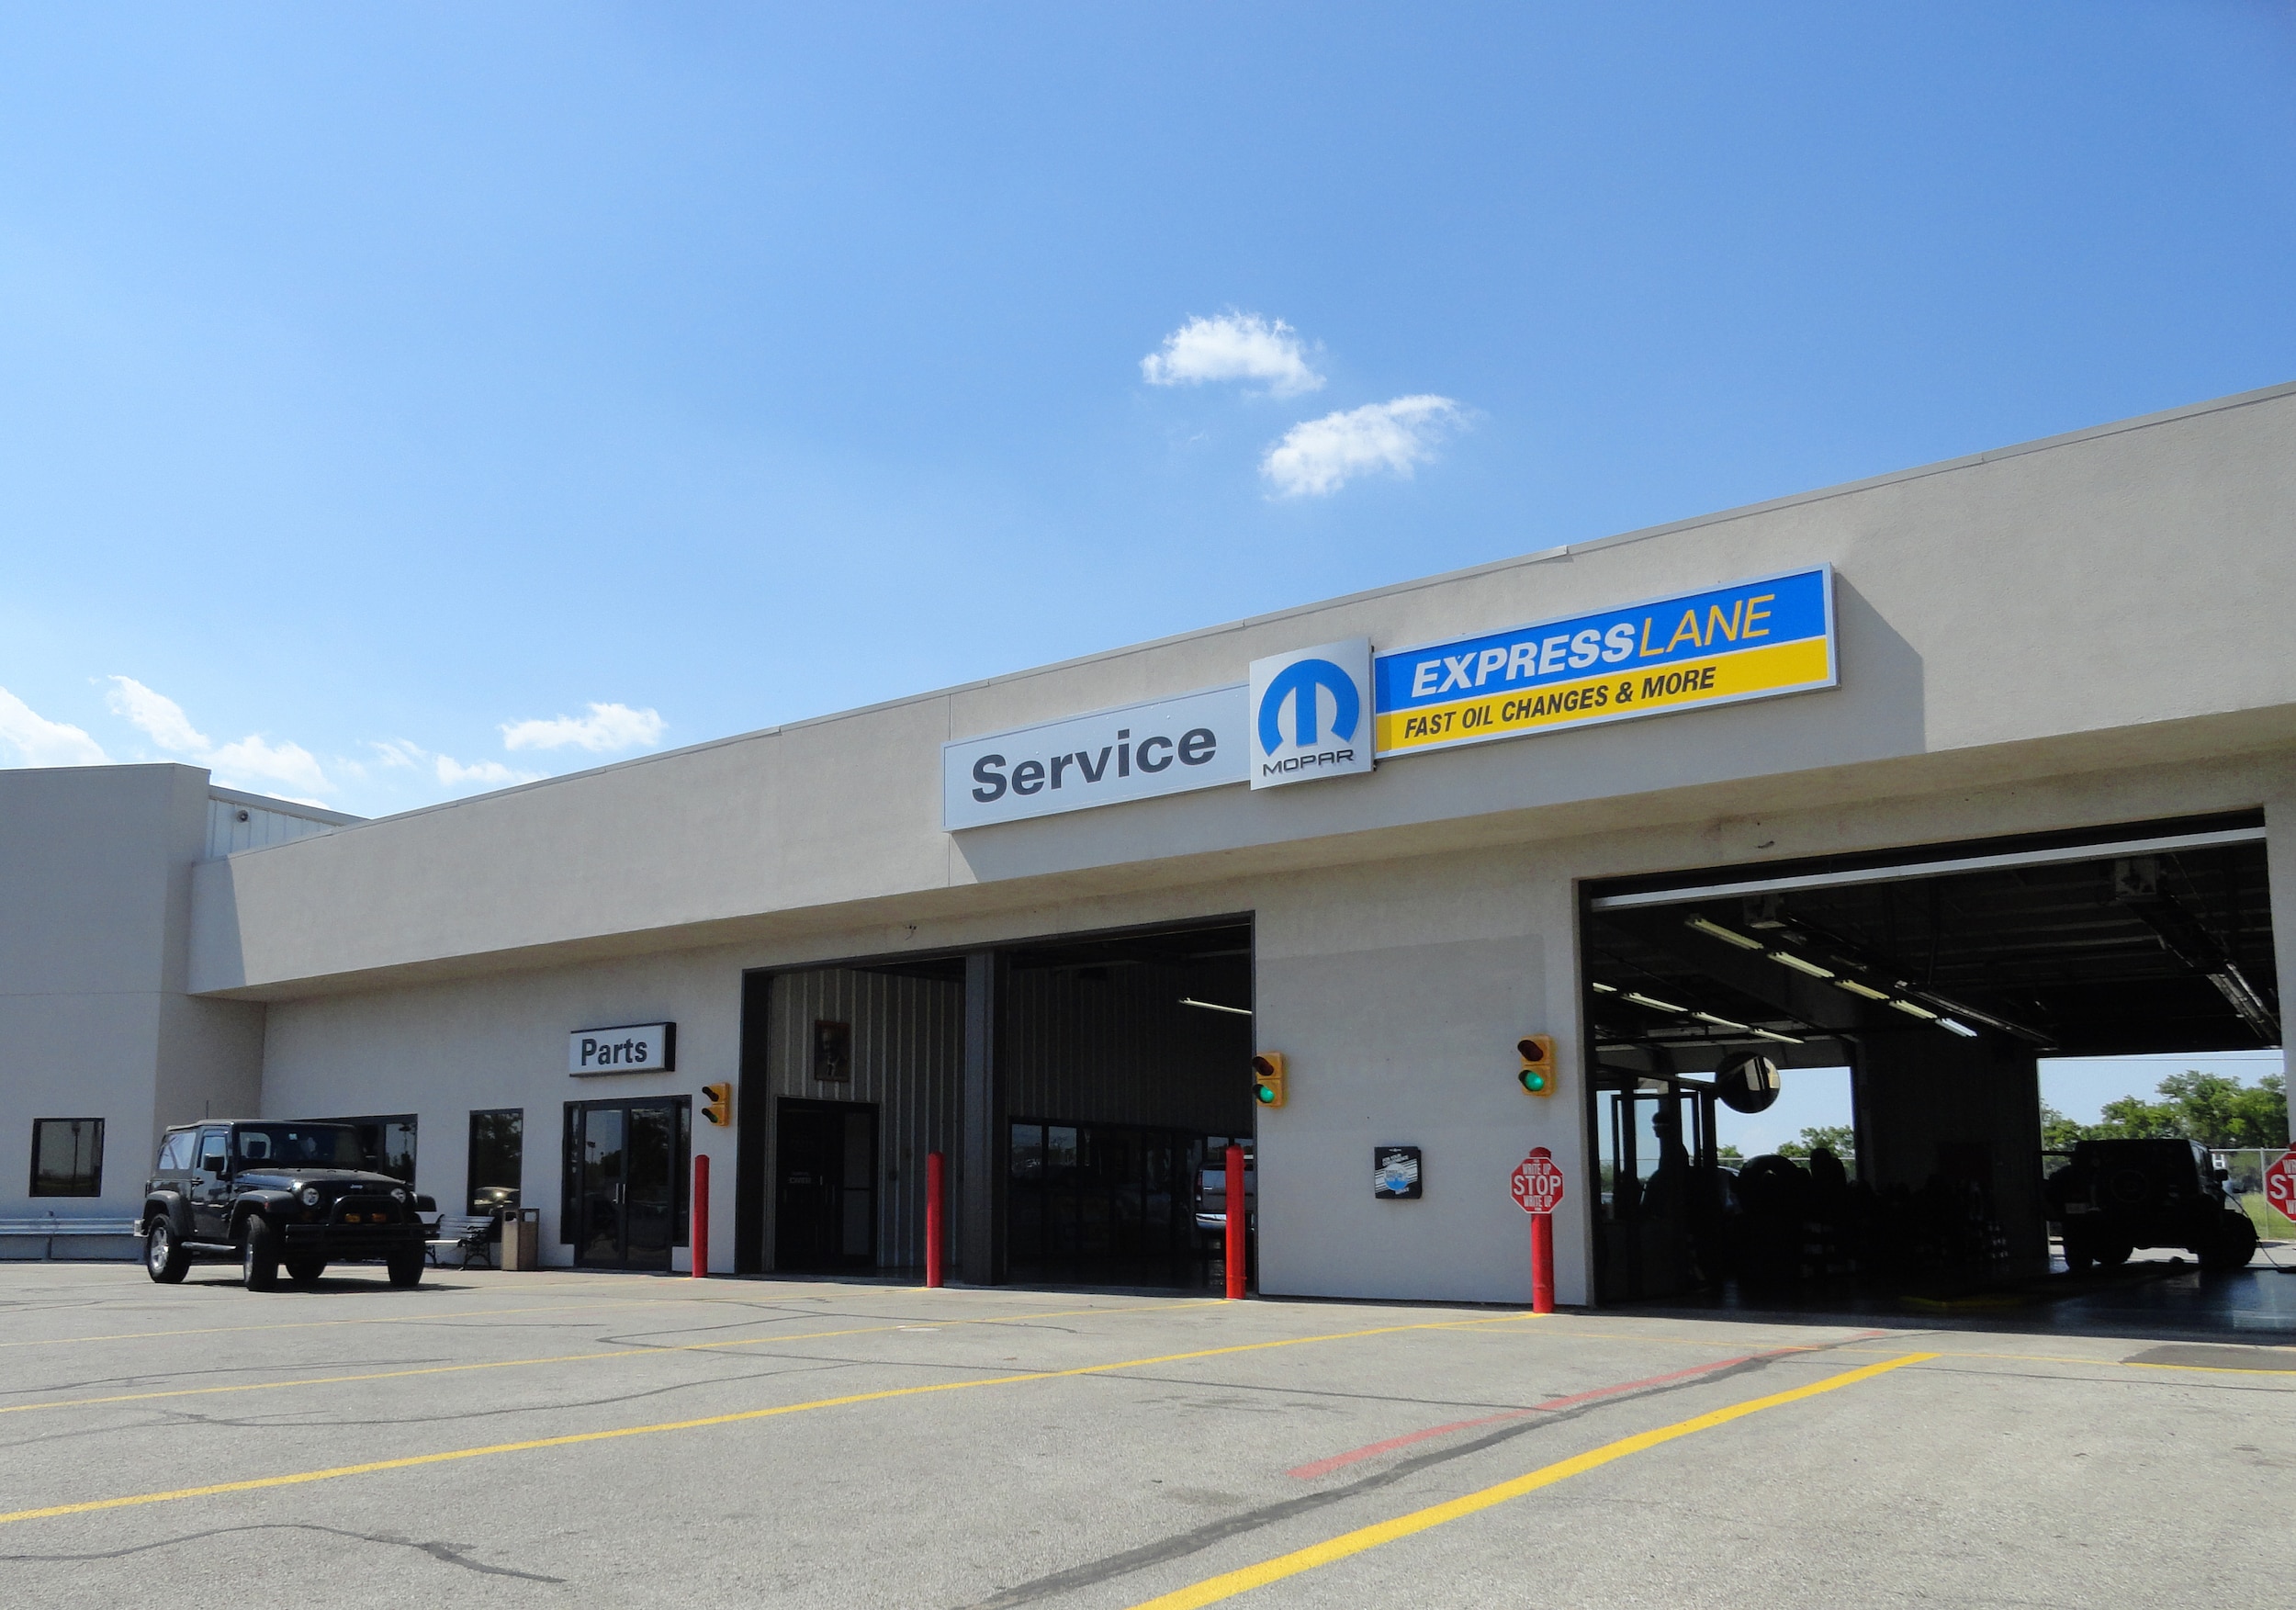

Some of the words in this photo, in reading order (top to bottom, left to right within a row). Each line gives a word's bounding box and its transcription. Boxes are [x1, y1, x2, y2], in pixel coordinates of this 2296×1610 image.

[1404, 711, 1457, 738] FAST
[1462, 704, 1493, 729] OIL
[1502, 685, 1609, 722] CHANGES
[1615, 681, 1634, 704] &
[1641, 666, 1716, 700] MORE
[972, 727, 1217, 803] Service
[1263, 749, 1355, 776] MOPAR
[581, 1038, 647, 1065] Parts
[1514, 1175, 1561, 1195] STOP
